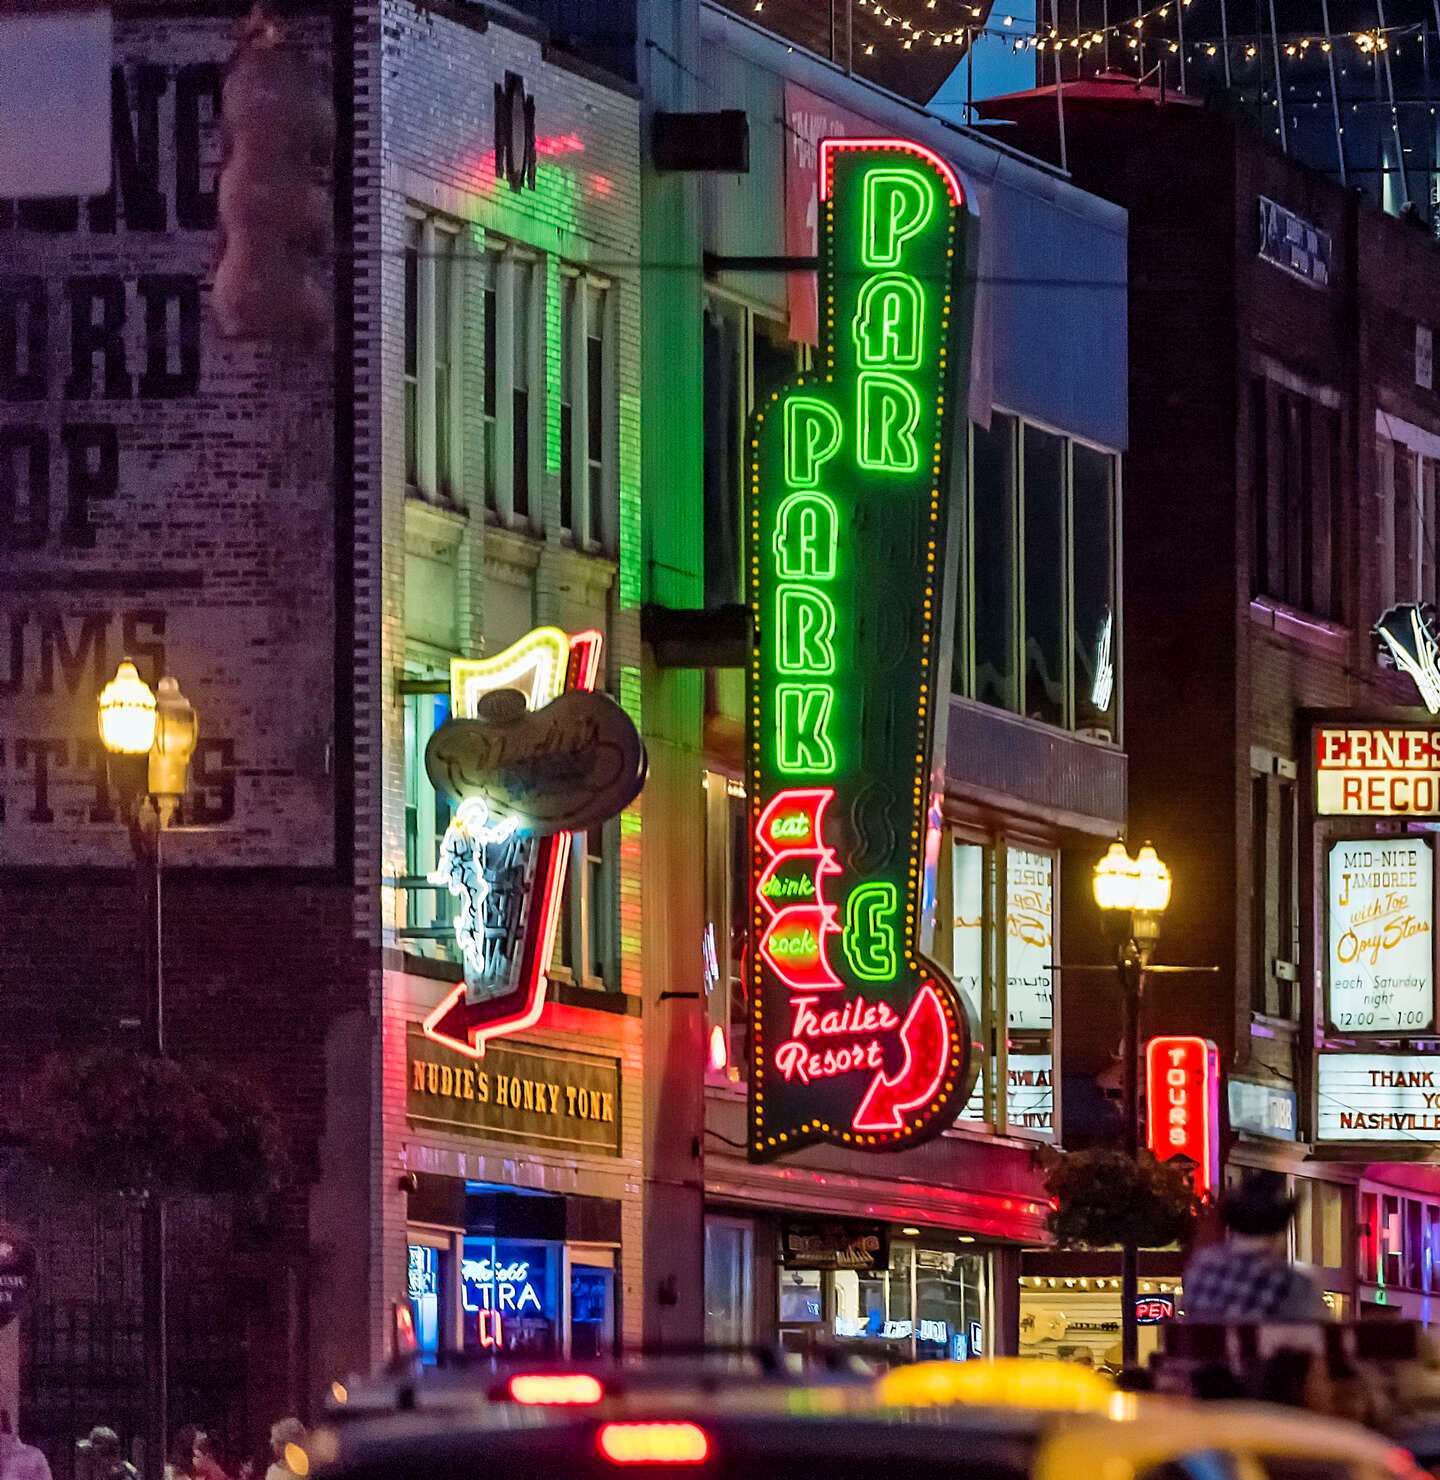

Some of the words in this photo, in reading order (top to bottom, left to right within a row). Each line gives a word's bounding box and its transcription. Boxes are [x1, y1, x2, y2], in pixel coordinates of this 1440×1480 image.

[773, 396, 843, 774] PARK
[770, 812, 811, 838] eat
[1343, 851, 1418, 869] MID-NITE
[762, 873, 815, 897] drink
[1339, 871, 1418, 906] JAMBOREE
[1350, 898, 1382, 924] with
[769, 929, 818, 953] rock
[1337, 927, 1382, 966] Opry
[1383, 914, 1430, 950] Stars
[1335, 975, 1363, 990] each
[1373, 975, 1426, 992] Saturday
[1363, 992, 1394, 1009] night
[789, 996, 900, 1038] Trailer
[1339, 1012, 1375, 1025] 12:00
[1397, 1010, 1424, 1025] 1:00
[775, 1038, 885, 1085] Resort
[413, 1060, 489, 1104] NUDIE'S
[496, 1075, 560, 1115] HONKY
[566, 1086, 614, 1122] TONK
[1368, 1070, 1434, 1088] THANK
[1167, 1048, 1187, 1146] TOURS
[462, 1282, 542, 1312] LTRA
[1136, 1302, 1173, 1318] PEN
